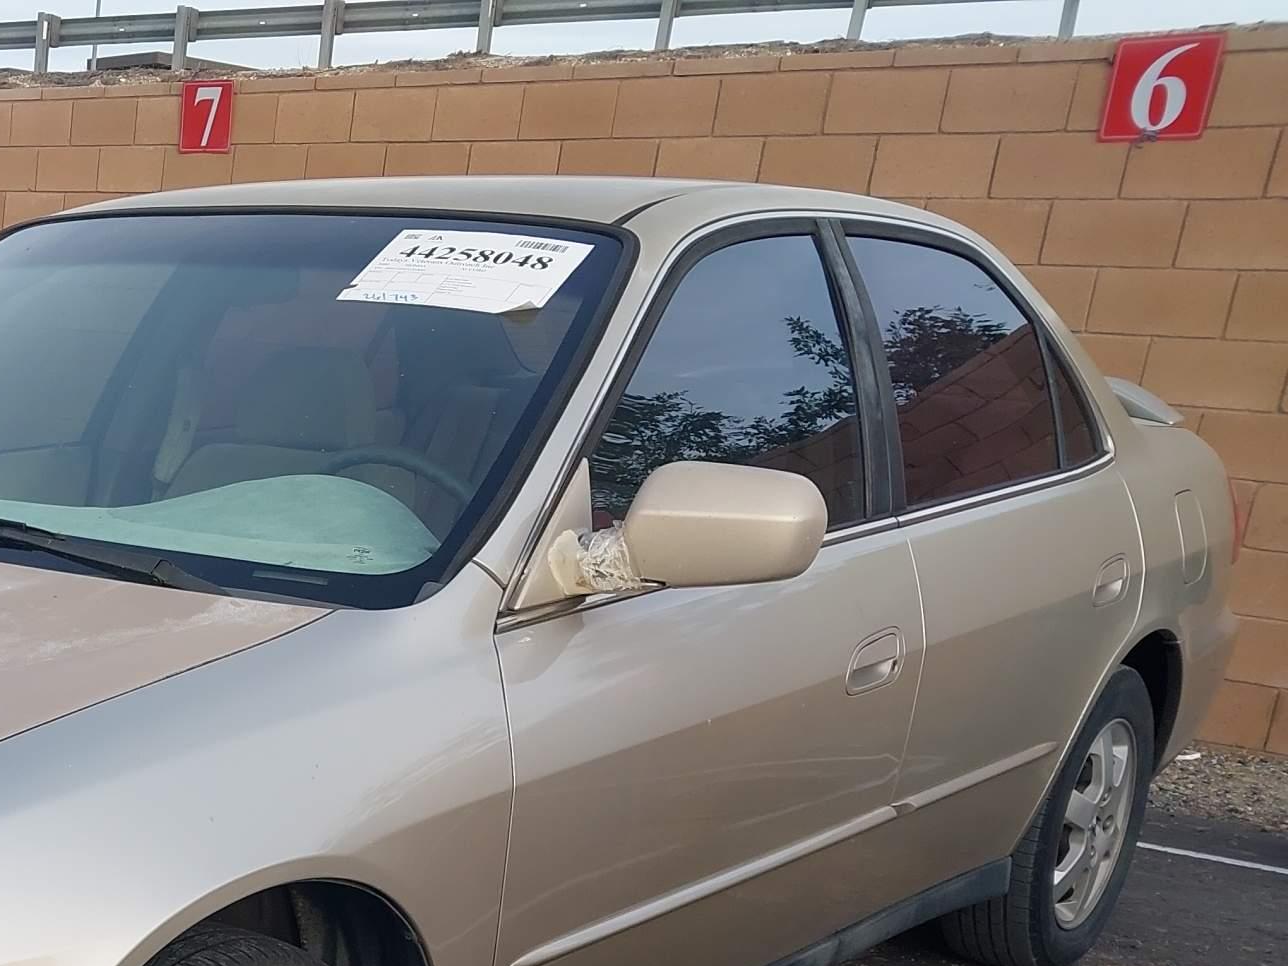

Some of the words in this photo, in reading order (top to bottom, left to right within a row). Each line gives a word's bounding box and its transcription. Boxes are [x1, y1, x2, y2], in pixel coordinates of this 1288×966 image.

[194, 86, 223, 147] 7
[1130, 42, 1201, 131] 6
[399, 244, 554, 270] 44258048
